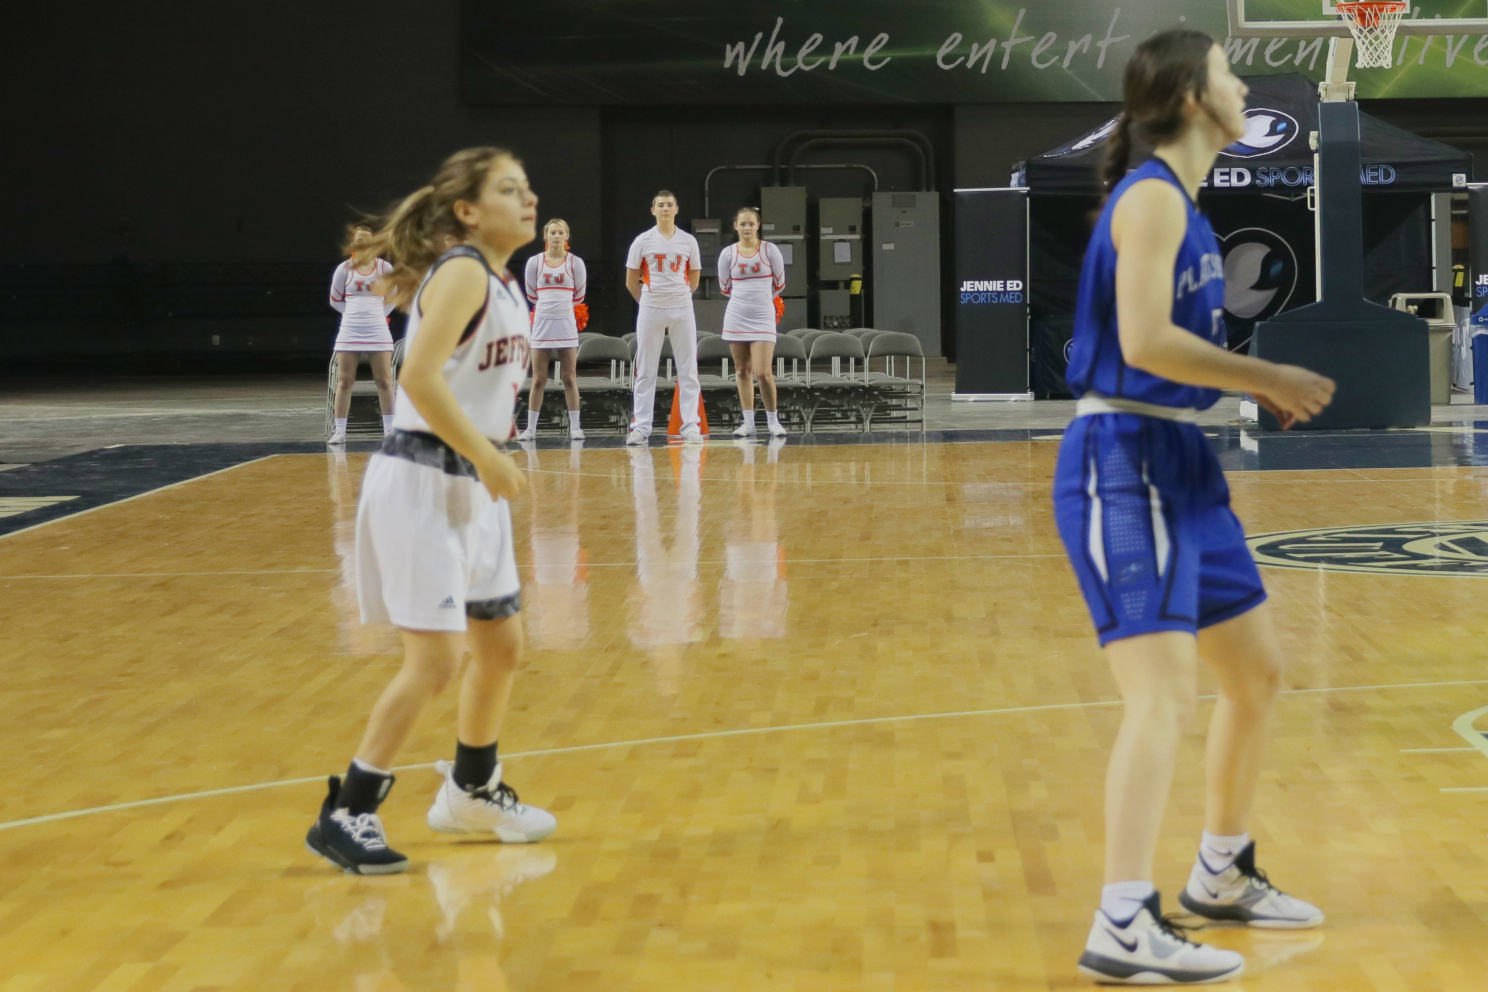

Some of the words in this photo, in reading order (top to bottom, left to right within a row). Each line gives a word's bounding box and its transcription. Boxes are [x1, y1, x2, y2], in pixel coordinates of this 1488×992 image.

[723, 16, 891, 77] where
[1213, 168, 1252, 187] ED
[653, 253, 683, 273] TJ
[738, 262, 761, 274] TJ
[543, 273, 565, 285] TJ
[960, 280, 1005, 291] JENNIE
[1006, 280, 1023, 291] ED
[960, 292, 999, 304] SPORTS
[1000, 292, 1023, 304] MED
